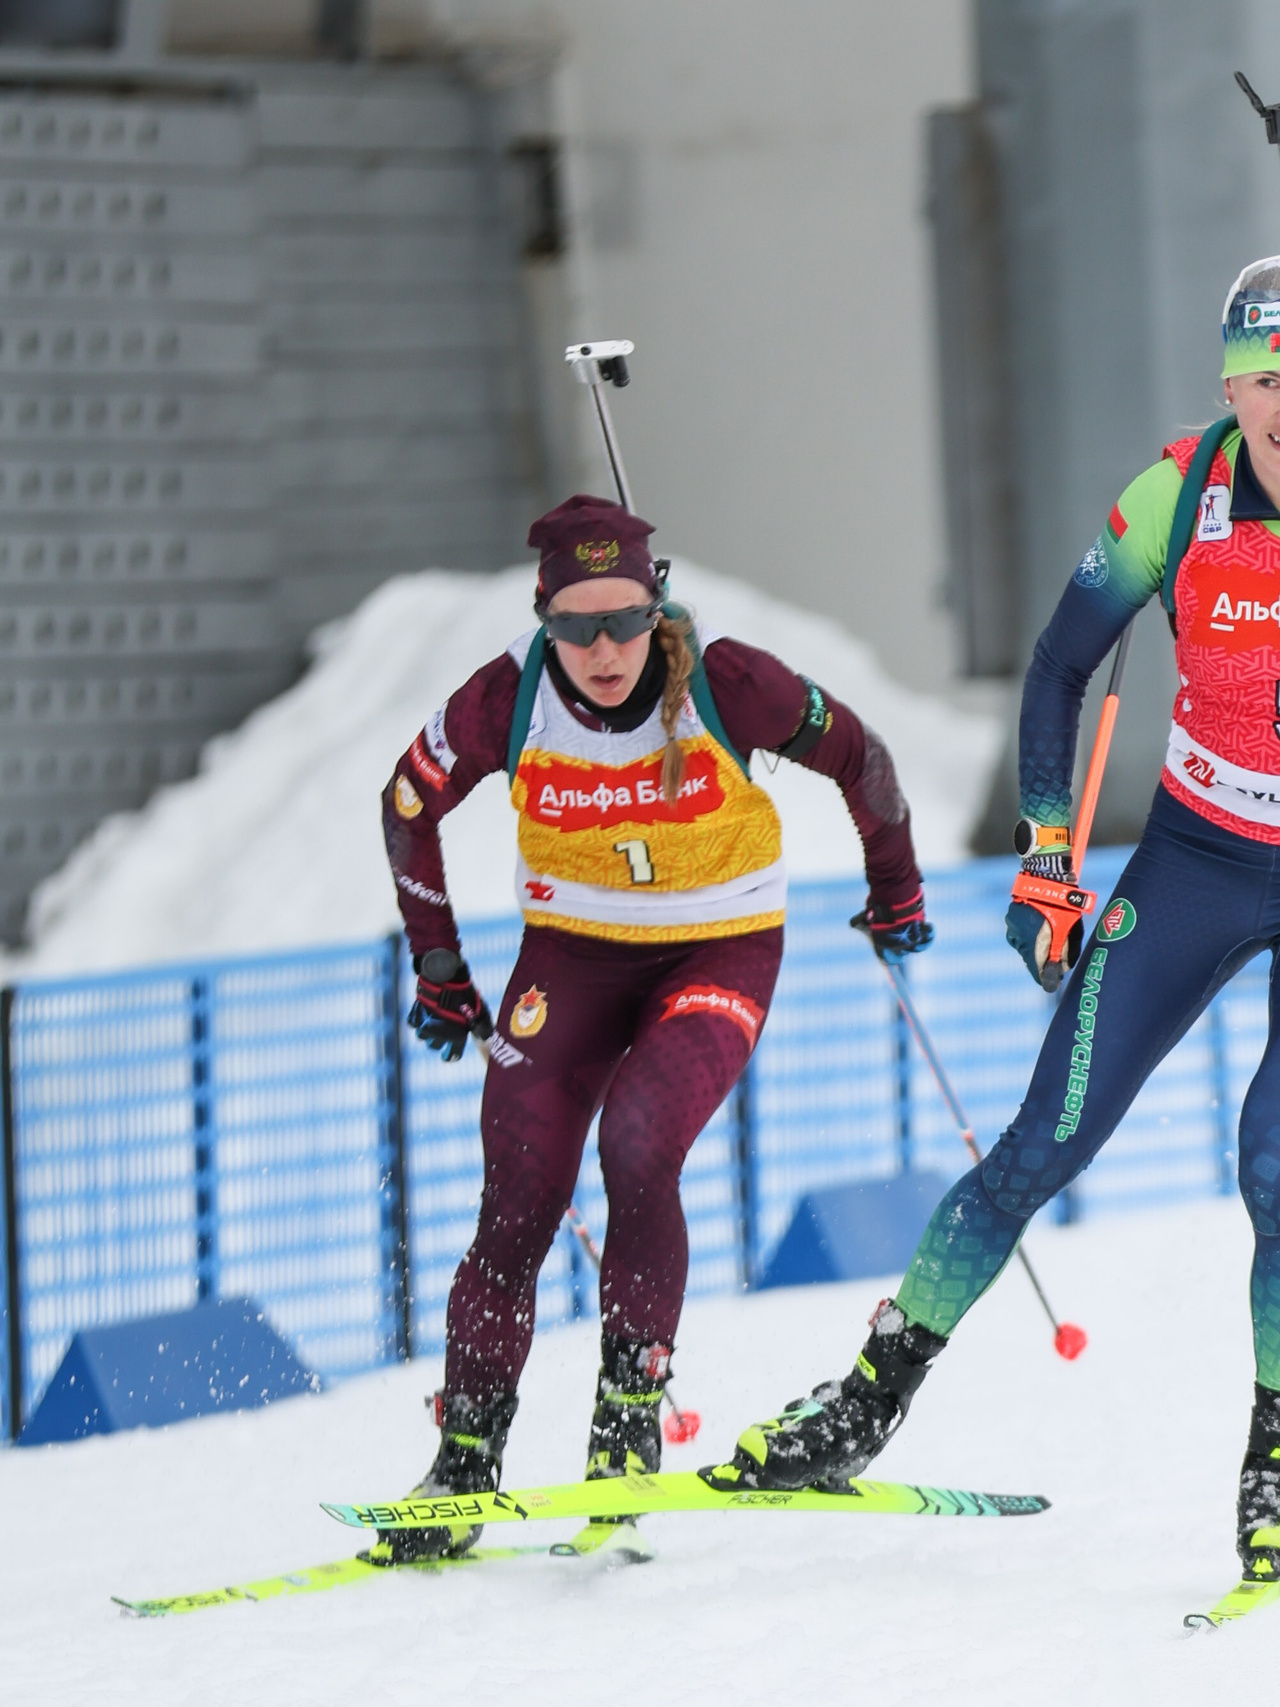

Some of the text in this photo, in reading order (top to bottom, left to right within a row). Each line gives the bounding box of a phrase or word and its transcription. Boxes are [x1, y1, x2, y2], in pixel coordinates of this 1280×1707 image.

[538, 782, 632, 814] Альфа
[613, 839, 655, 885] 1
[674, 993, 730, 1010] Альфа
[1054, 947, 1108, 1142] БЕЛОРУСНЕФТЬ
[352, 1498, 483, 1524] FISCHER
[727, 1493, 793, 1506] FISCHER
